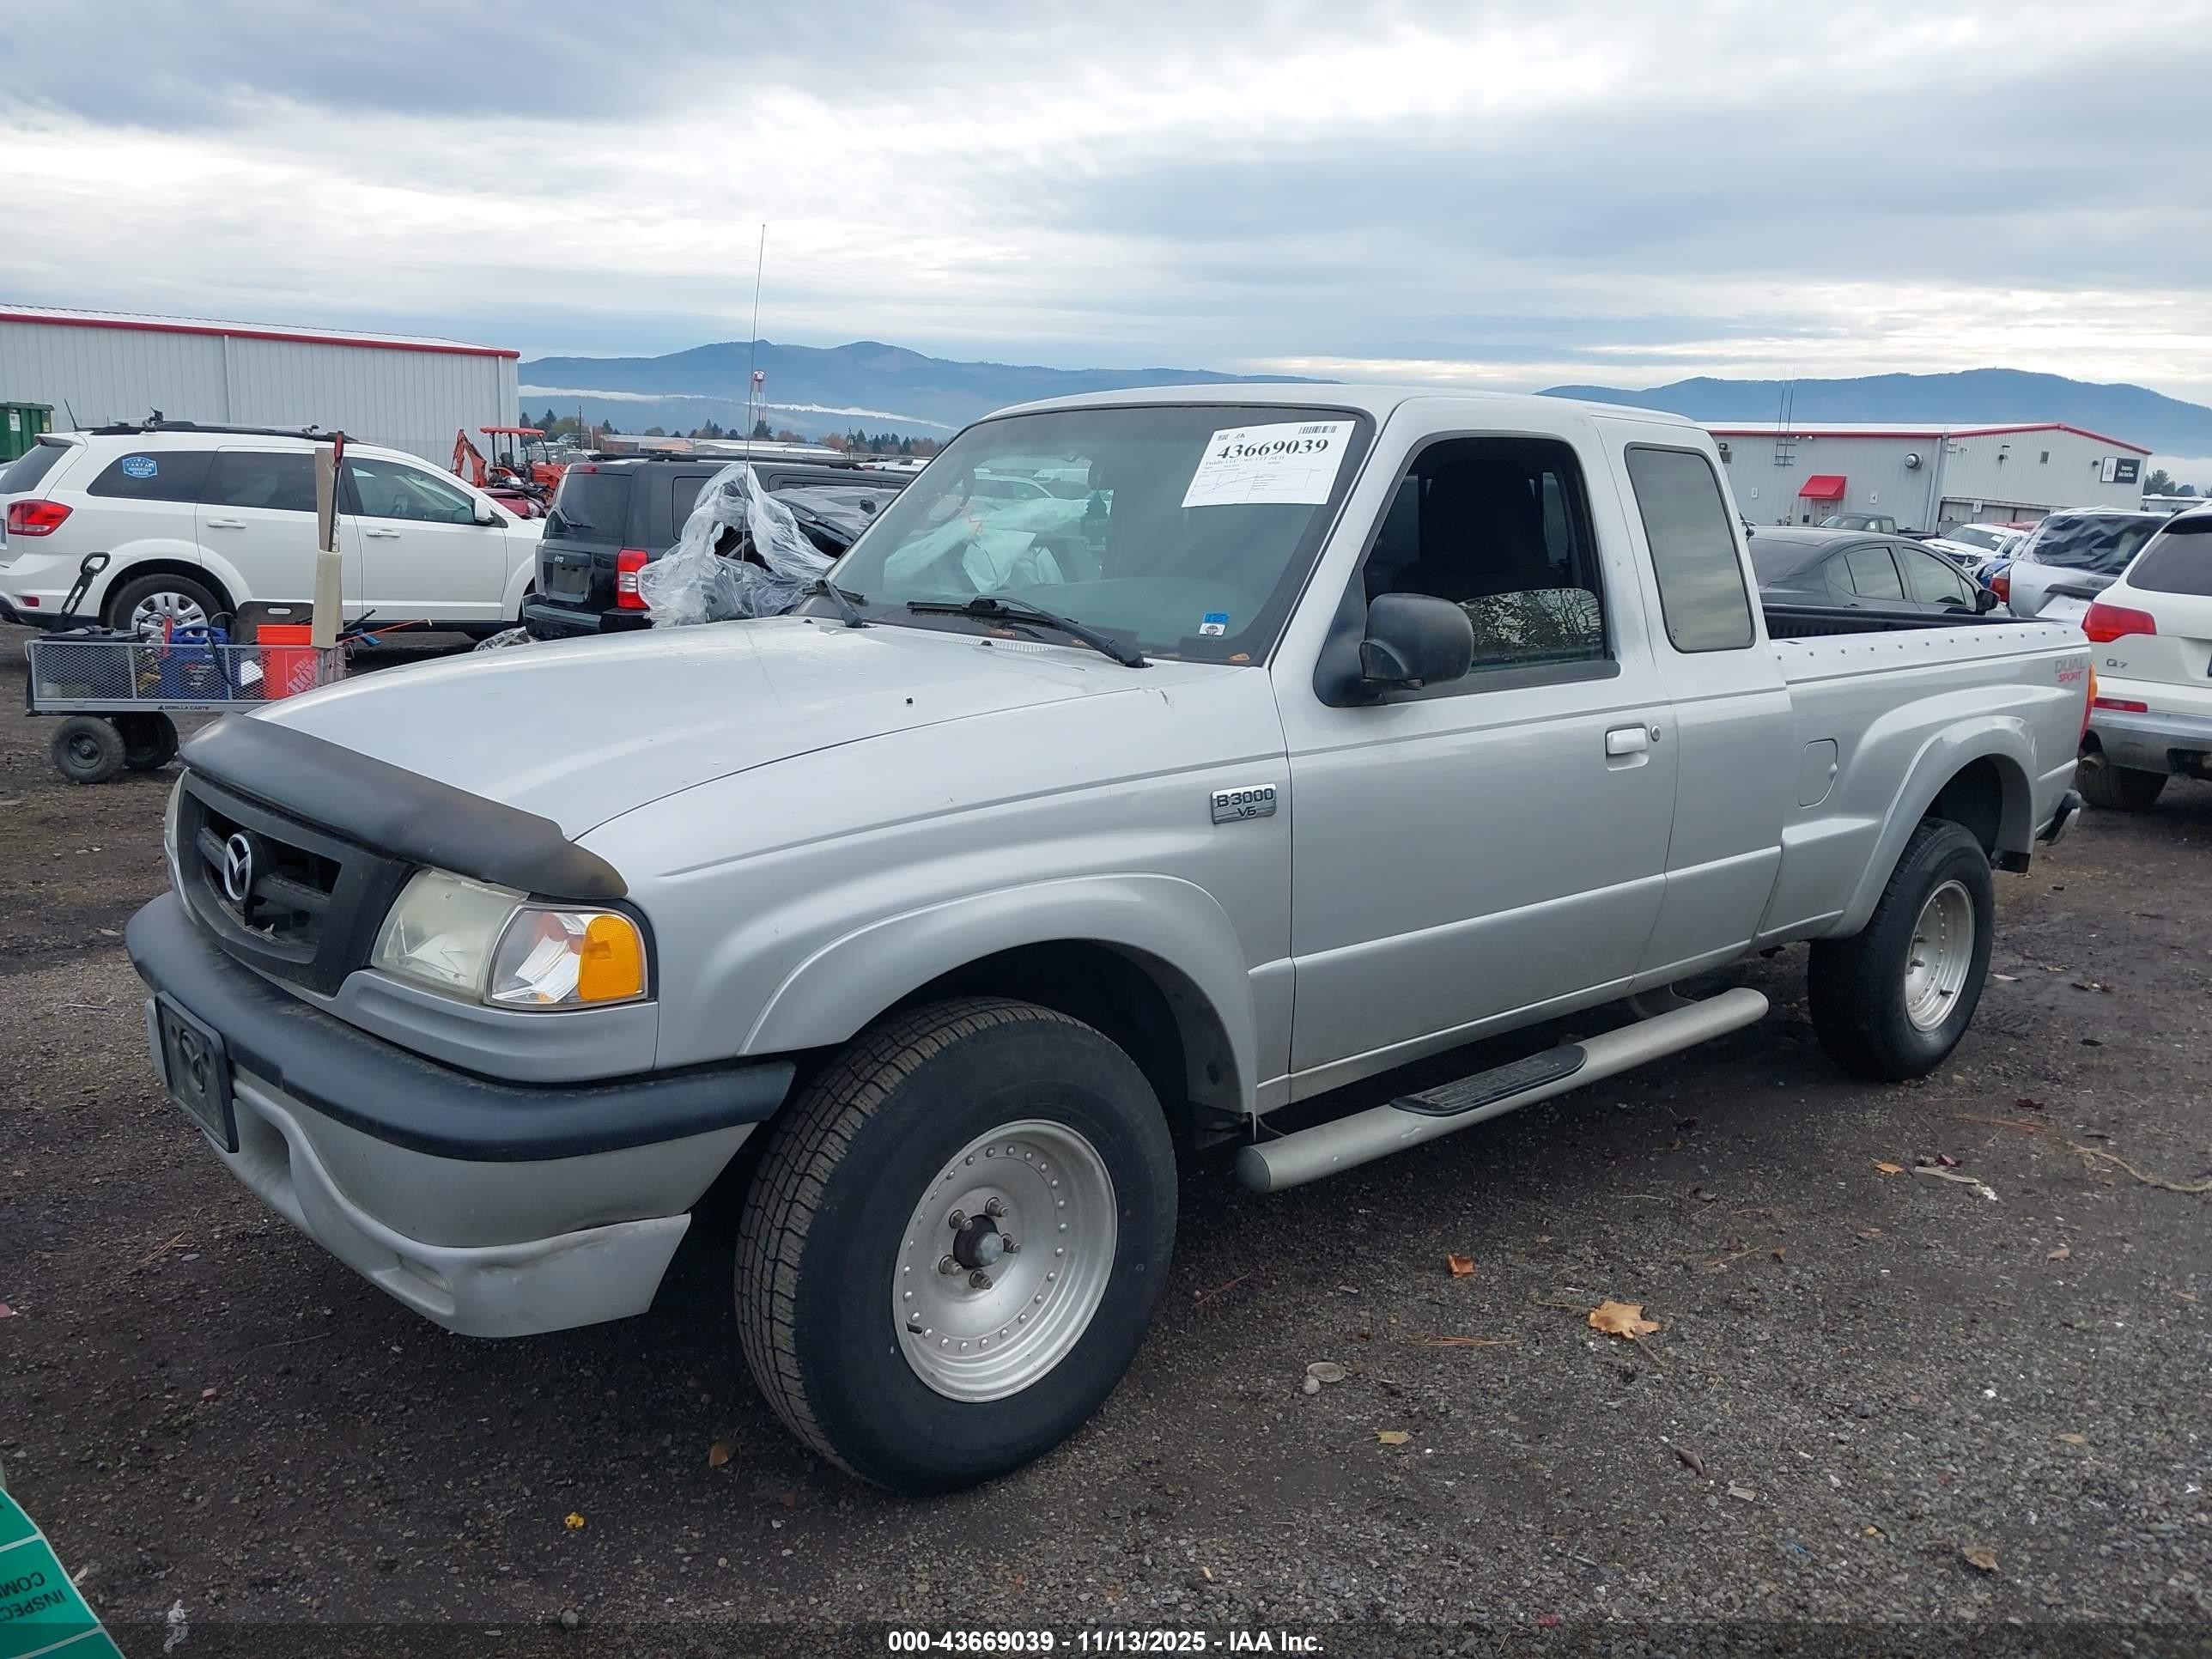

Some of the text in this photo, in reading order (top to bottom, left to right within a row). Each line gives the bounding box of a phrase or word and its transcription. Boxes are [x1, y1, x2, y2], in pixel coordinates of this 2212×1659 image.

[1217, 439, 1329, 459] 43669039
[2055, 657, 2086, 673] DUAL
[2106, 658, 2128, 668] Q7
[2057, 672, 2083, 683] SPORT
[1216, 787, 1274, 808] B3000
[1237, 805, 1257, 817] V6
[0, 1589, 67, 1622] INSPEC
